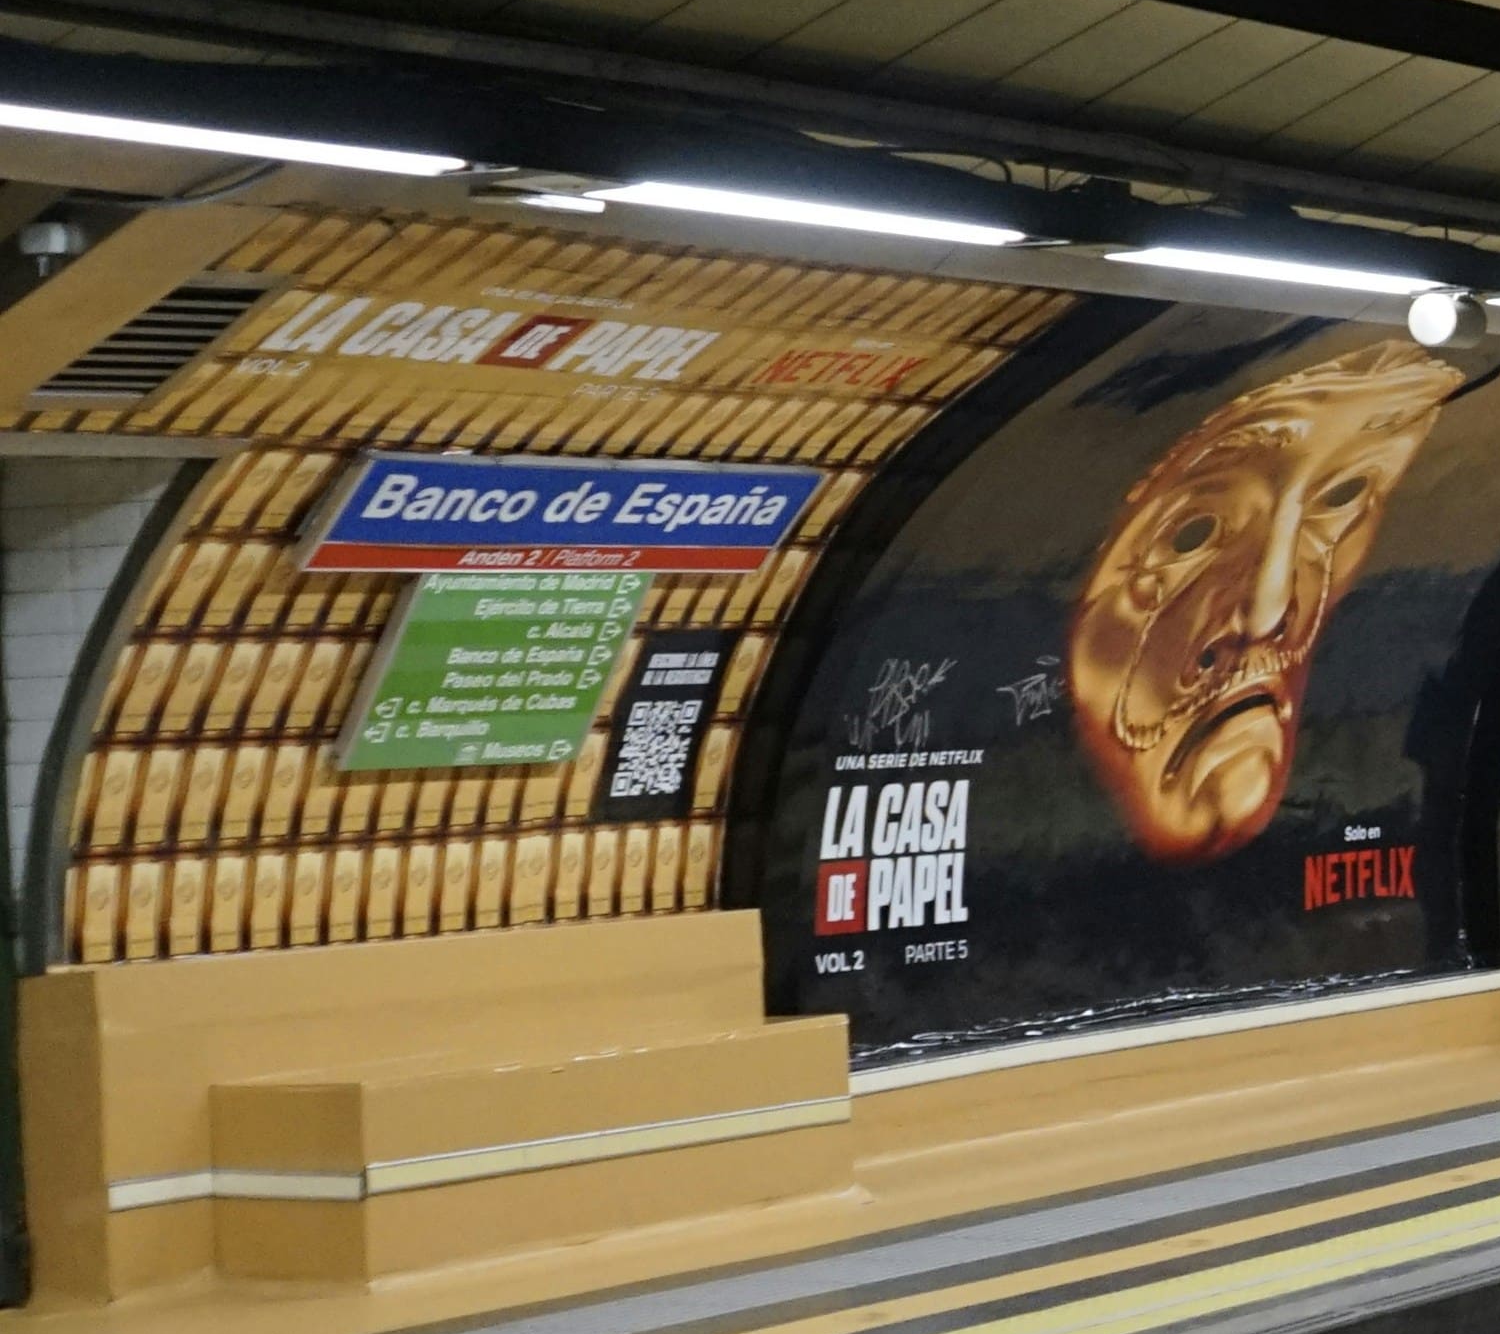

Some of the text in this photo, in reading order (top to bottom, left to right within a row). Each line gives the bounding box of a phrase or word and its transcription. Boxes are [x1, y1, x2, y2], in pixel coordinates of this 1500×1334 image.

[257, 293, 723, 381] LA CASA DE PAPEL
[361, 473, 788, 533] Banco de España
[523, 549, 543, 566] 2
[550, 549, 625, 567] Platform
[622, 550, 641, 567] 2
[539, 575, 559, 591] de
[538, 599, 559, 615] de
[447, 647, 498, 665] Banco
[501, 647, 524, 664] de
[501, 695, 524, 711] de
[481, 742, 546, 759] Museos
[835, 749, 985, 770] UNA SERIE DE NETFLIX
[819, 779, 970, 860] LA CASA
[1344, 825, 1381, 841] Solo en
[1304, 845, 1416, 911] NETFLIX
[826, 851, 969, 932] DE PAPEL
[815, 950, 865, 974] VOL 2
[905, 939, 969, 965] PARTE 5
